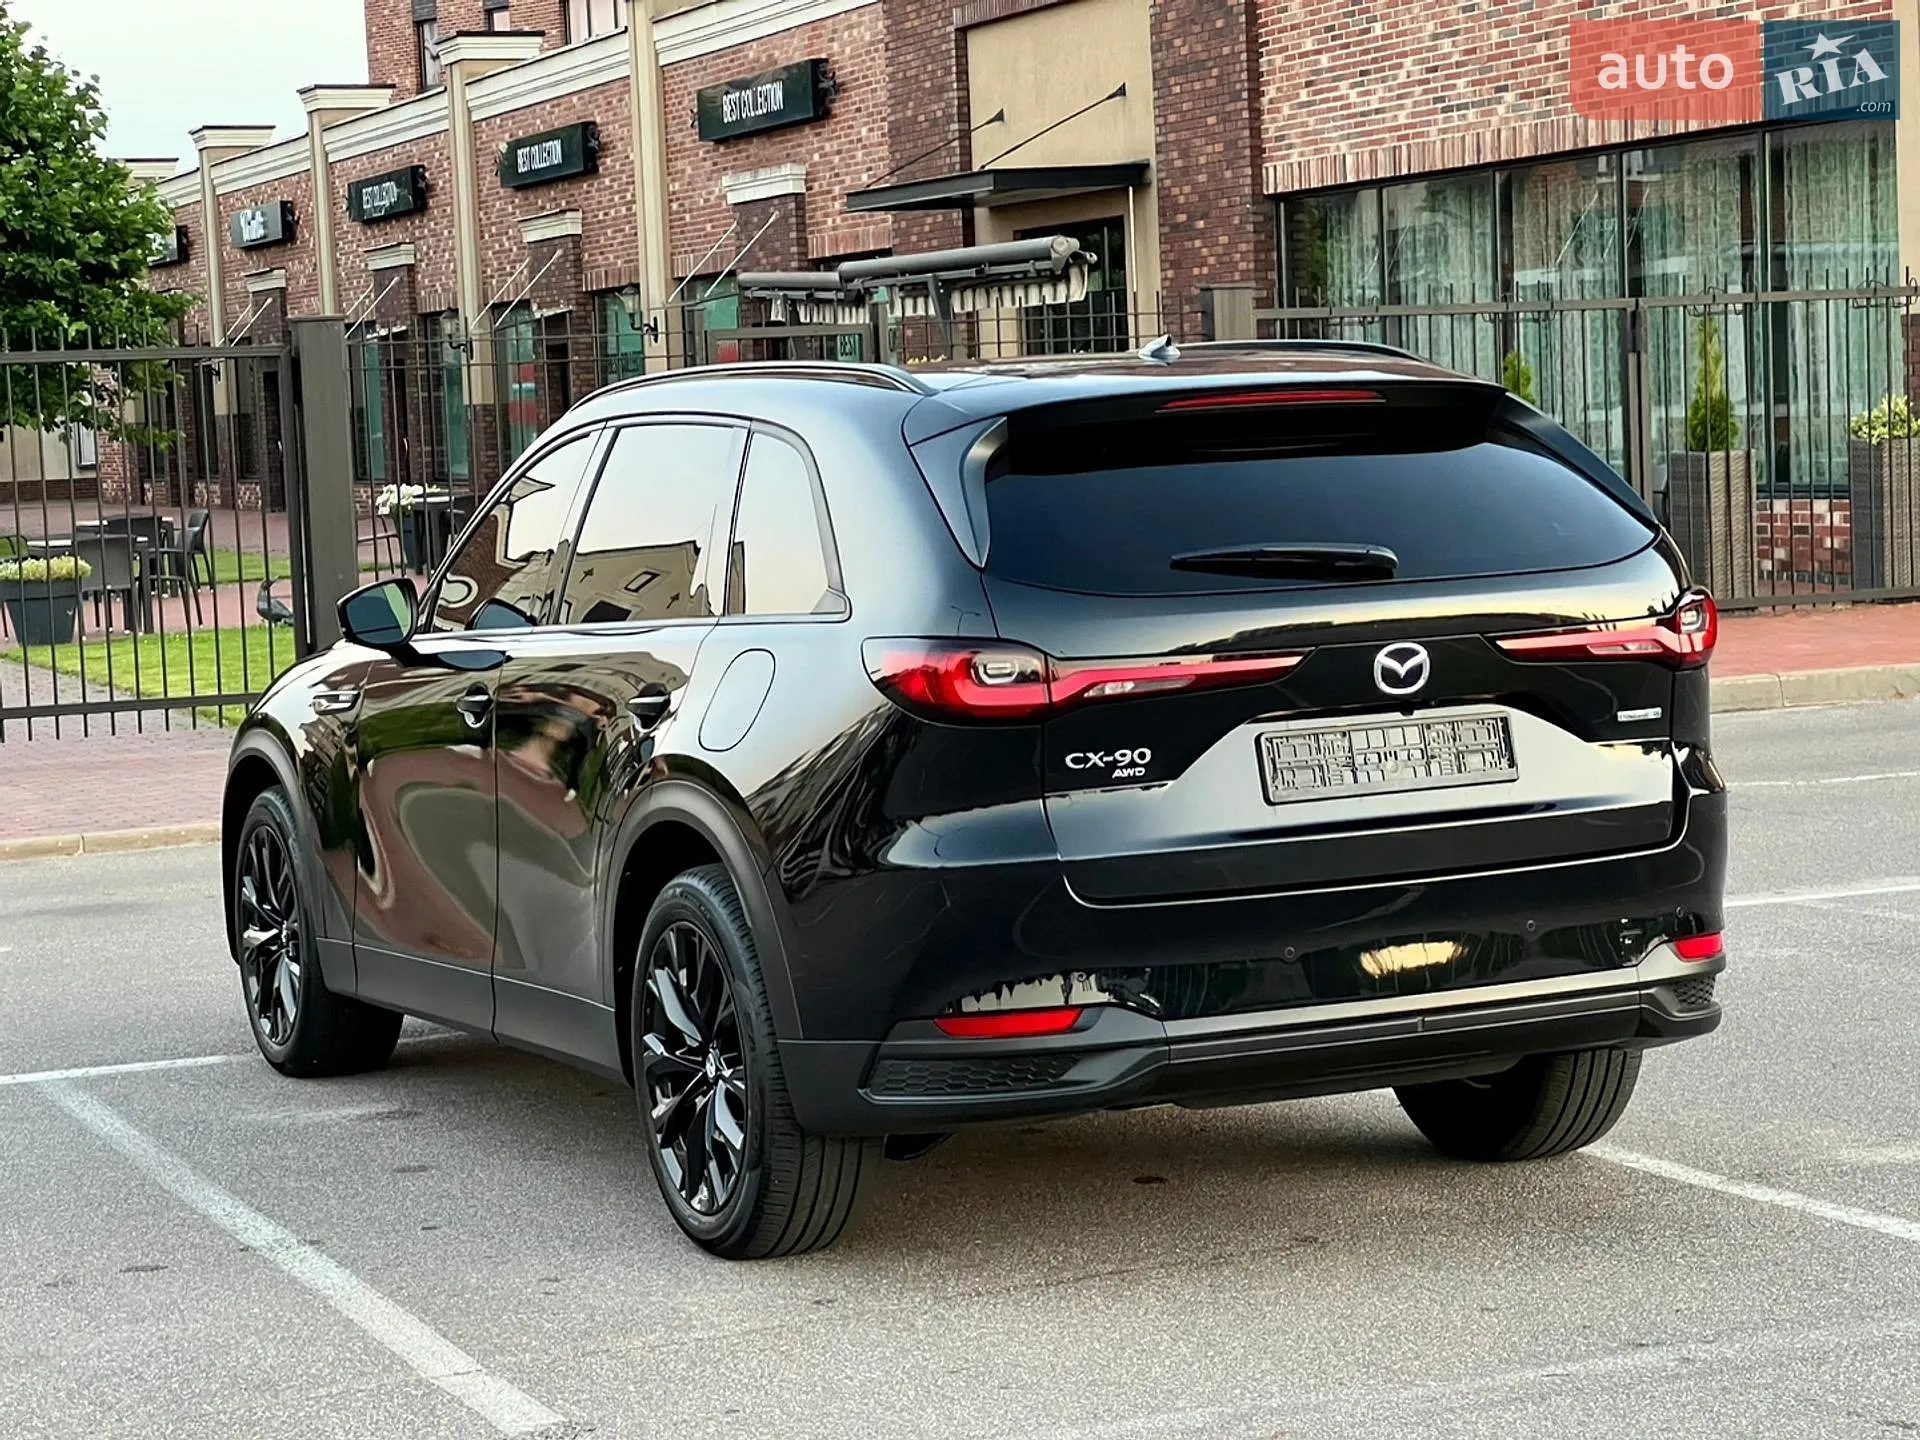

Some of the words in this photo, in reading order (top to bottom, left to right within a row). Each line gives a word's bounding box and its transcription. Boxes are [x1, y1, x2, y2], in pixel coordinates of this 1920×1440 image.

[722, 91, 740, 123] BEST
[740, 80, 784, 119] COLLECTION
[517, 146, 530, 173] BEST
[530, 139, 562, 170] COLLECTION
[1064, 747, 1152, 769] CX-90
[1111, 766, 1146, 779] AWD
